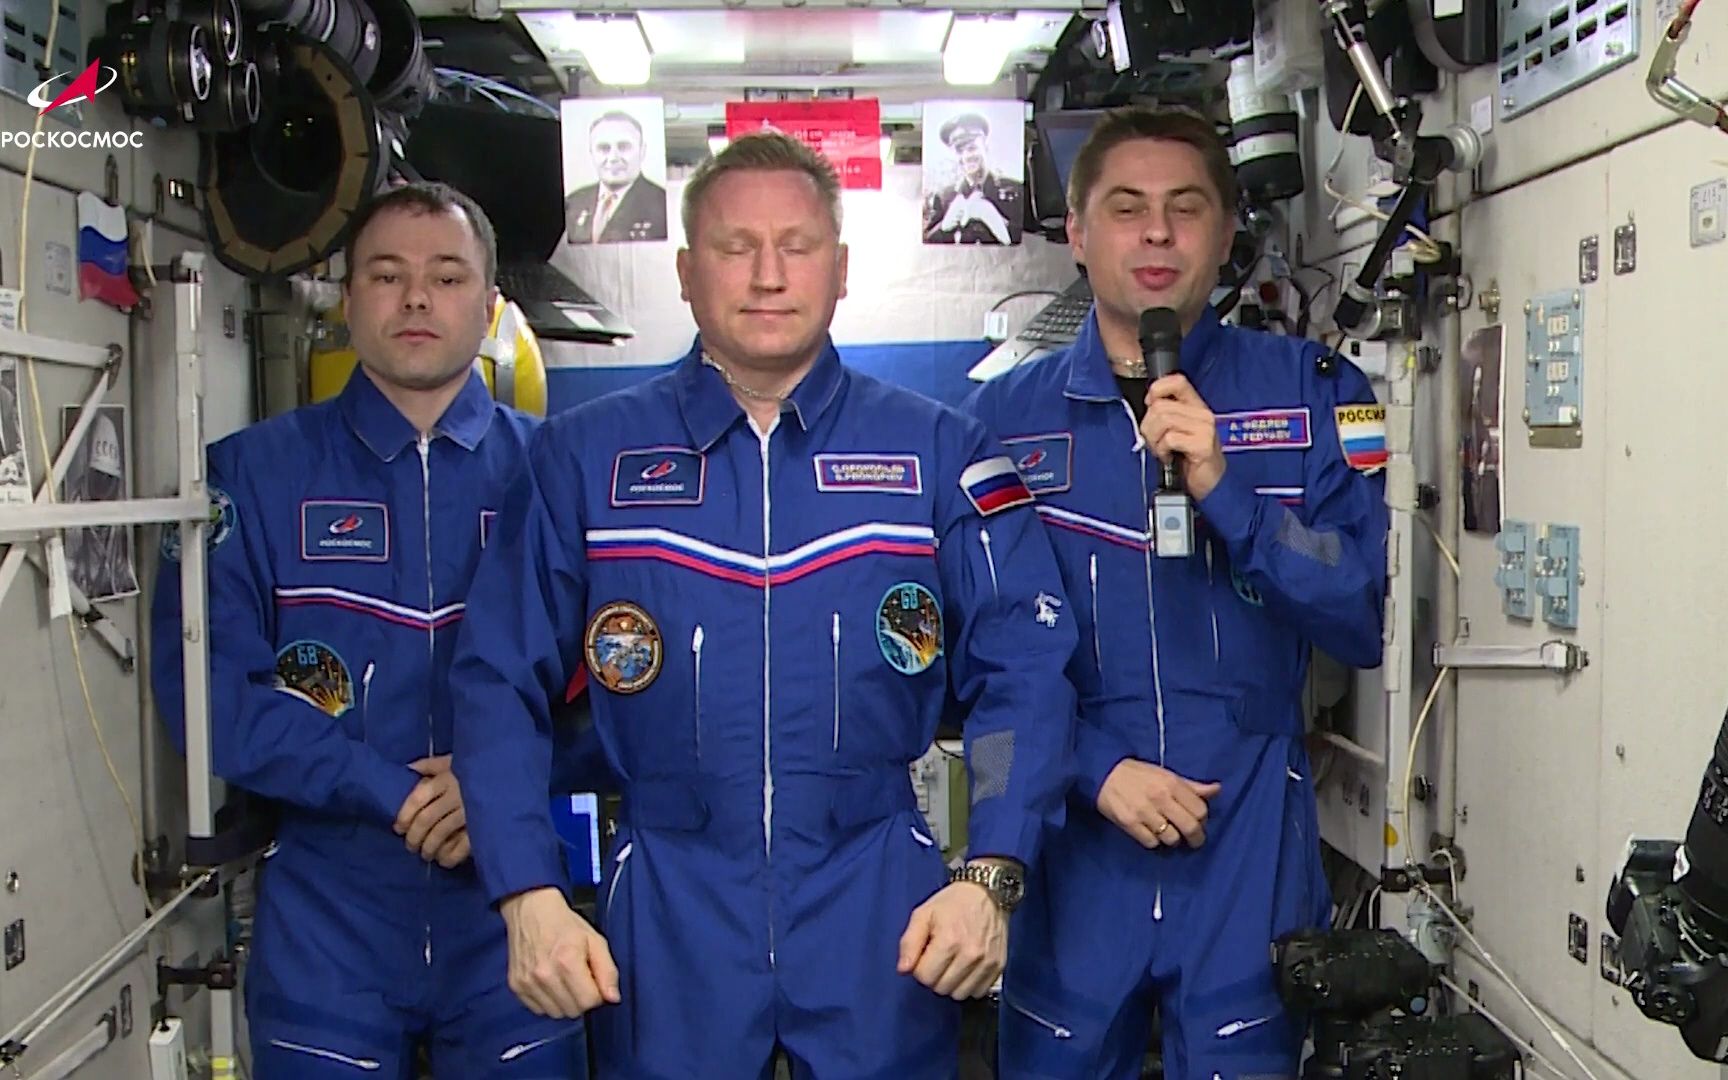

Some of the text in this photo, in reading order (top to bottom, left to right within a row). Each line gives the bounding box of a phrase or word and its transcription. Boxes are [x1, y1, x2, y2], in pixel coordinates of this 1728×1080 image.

[1338, 408, 1385, 424] РОССИ
[902, 590, 918, 609] 68
[297, 645, 318, 665] 68
